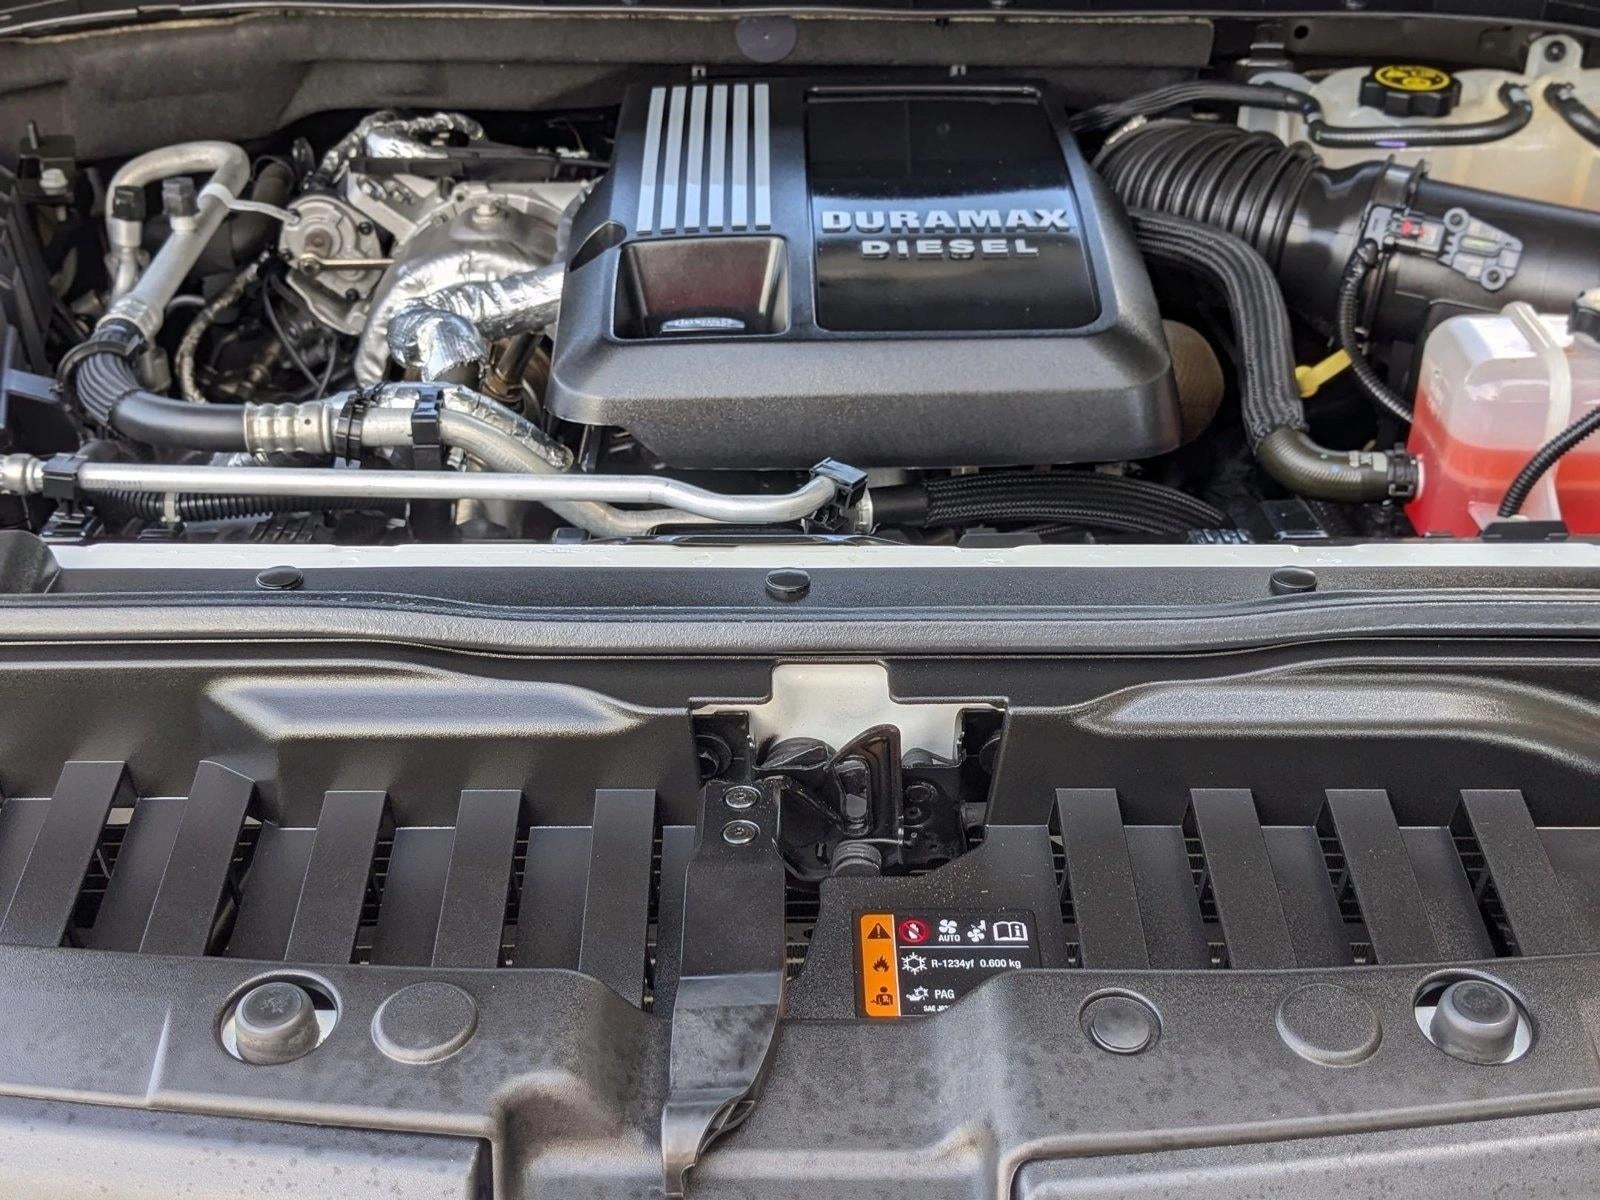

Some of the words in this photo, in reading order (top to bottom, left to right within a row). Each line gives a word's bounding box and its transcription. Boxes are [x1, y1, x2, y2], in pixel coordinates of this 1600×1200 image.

[821, 208, 1071, 233] DURAMAX
[861, 238, 1040, 259] DIESEL
[938, 934, 961, 942] AUTO
[931, 959, 975, 969] R-1234yf
[979, 959, 1007, 968] 0.600
[1008, 959, 1022, 969] kg
[934, 989, 955, 999] PAG
